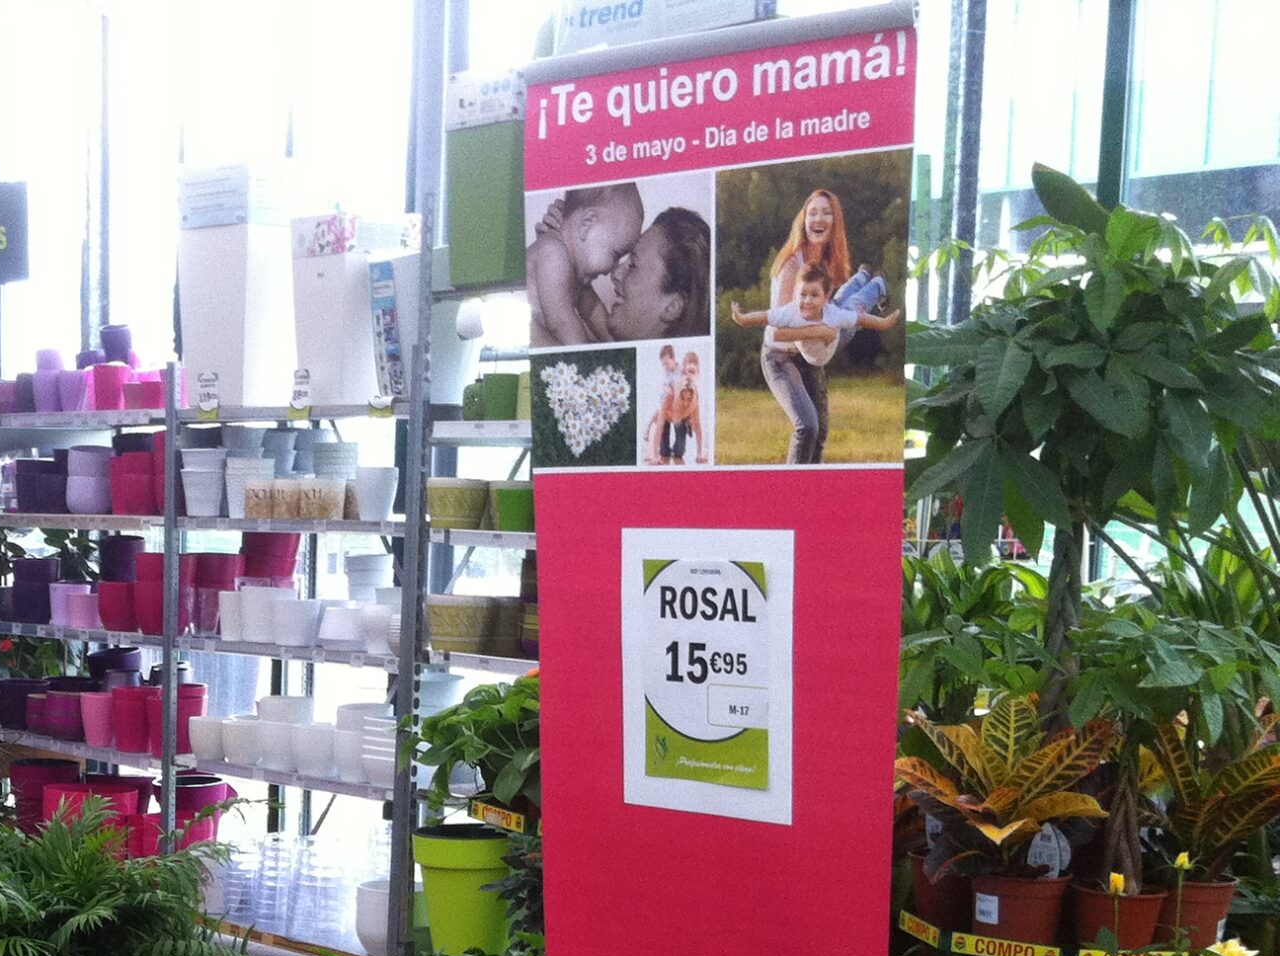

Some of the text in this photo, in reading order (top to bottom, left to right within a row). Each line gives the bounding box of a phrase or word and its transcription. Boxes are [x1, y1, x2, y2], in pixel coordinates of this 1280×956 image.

[579, 0, 643, 29] trend
[538, 83, 593, 140] ¡Te
[607, 68, 738, 127] quiero
[752, 30, 907, 97] mamá!
[585, 143, 597, 166] 3
[603, 139, 627, 164] de
[633, 135, 686, 161] mayo
[705, 125, 737, 149] Día
[743, 121, 768, 144] de
[775, 118, 794, 139] la
[800, 109, 870, 136] madre
[660, 585, 757, 623] ROSAL
[665, 640, 748, 684] 15€95
[729, 705, 750, 716] M-17
